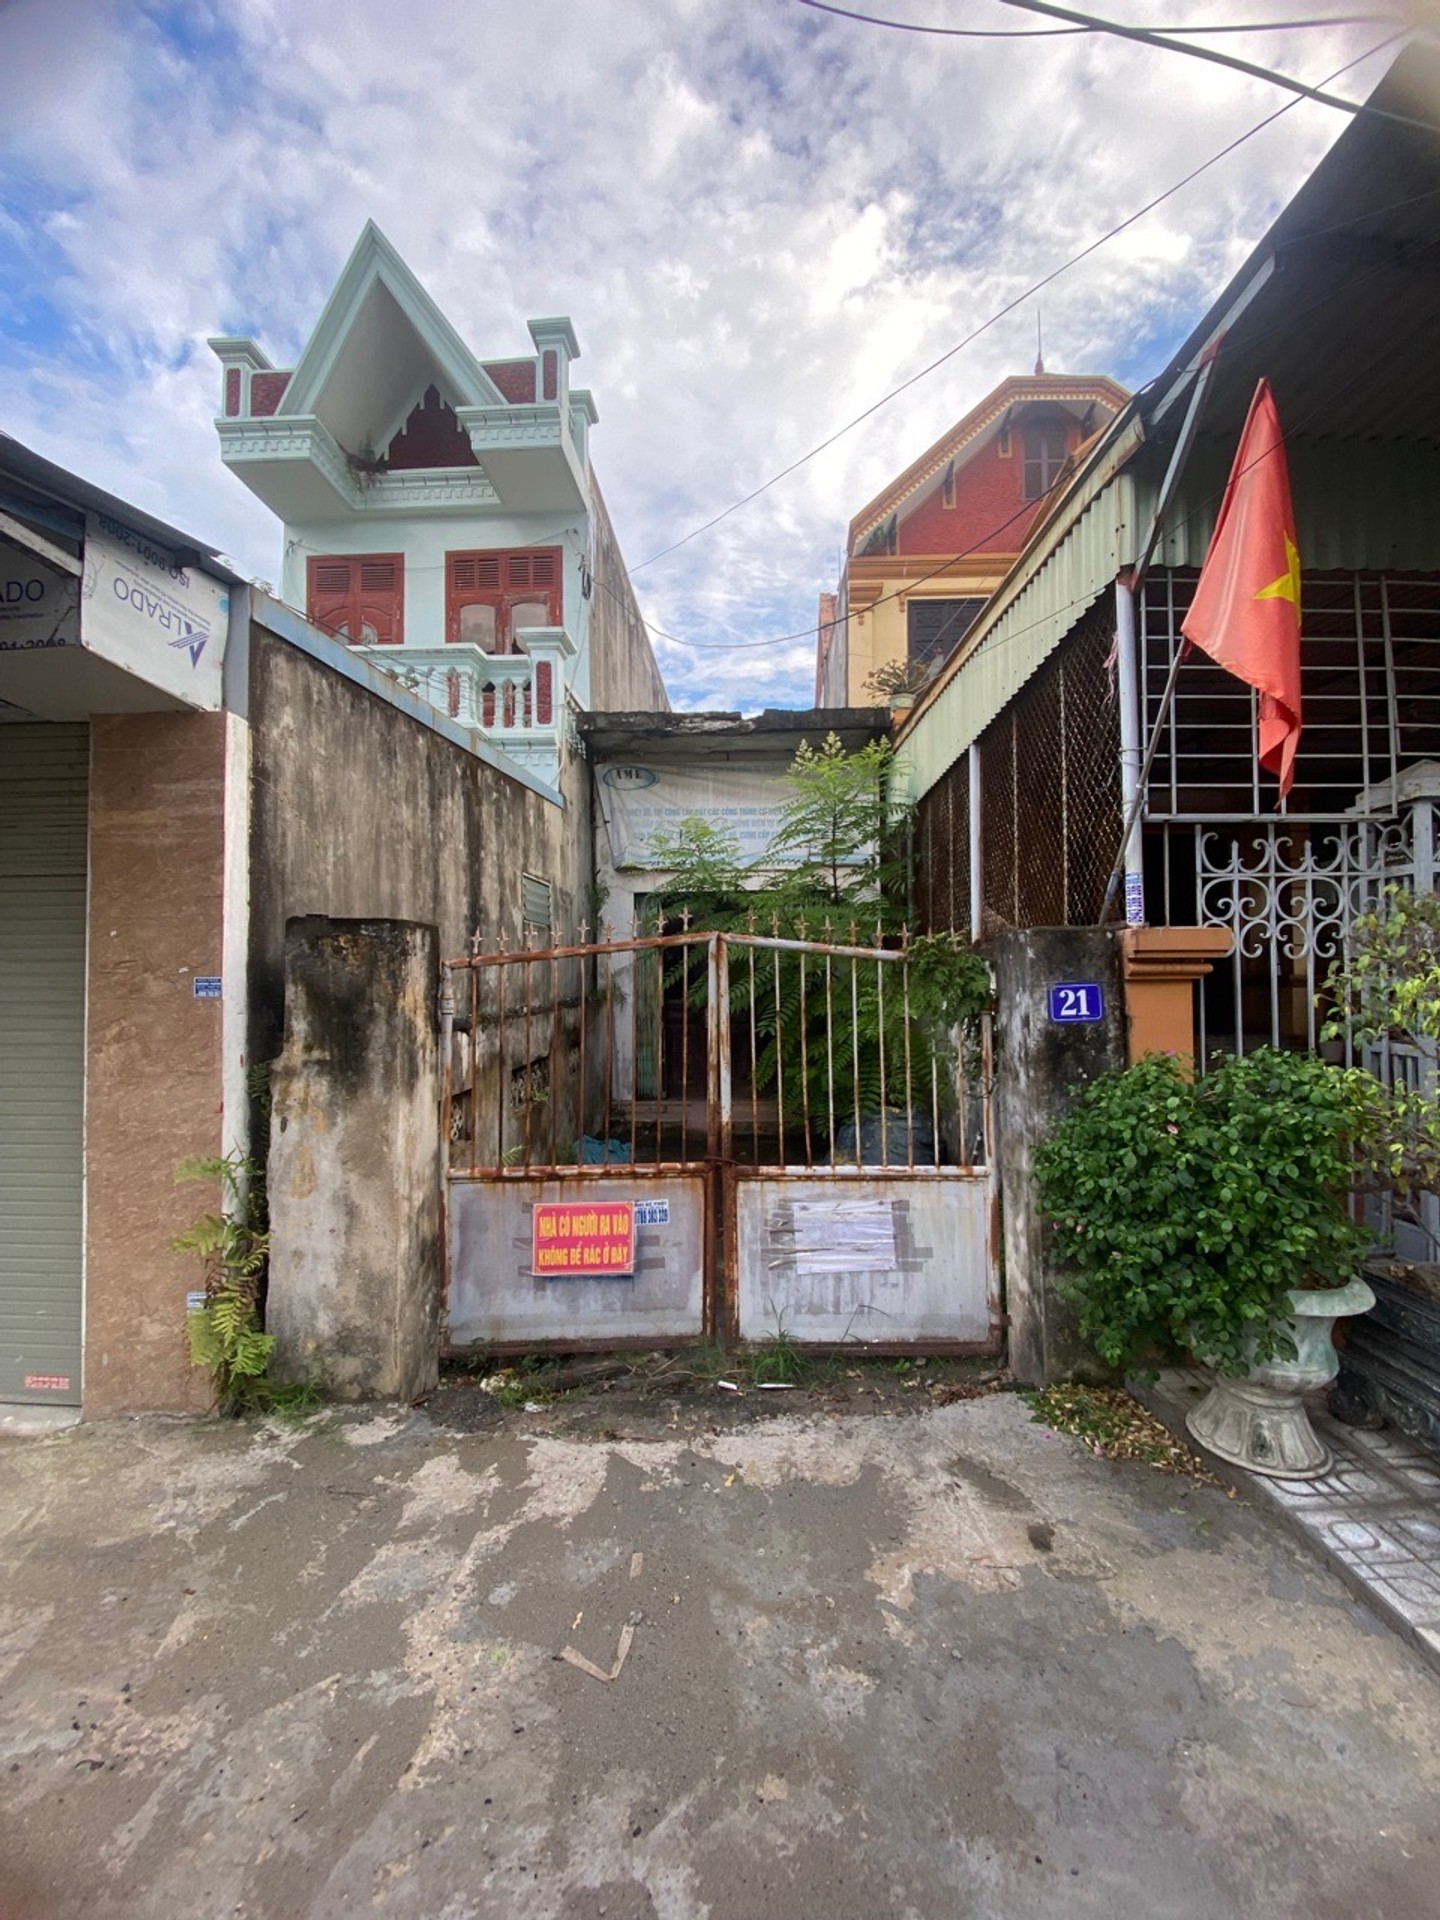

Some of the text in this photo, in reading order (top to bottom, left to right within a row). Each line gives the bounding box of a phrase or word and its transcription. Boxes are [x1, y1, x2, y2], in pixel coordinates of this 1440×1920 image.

[0, 578, 45, 603] DO
[113, 577, 209, 670] ALRADO
[1059, 988, 1090, 1016] 21
[539, 1209, 629, 1237] NHÀ CÓ NGƯỜI RA VÀO
[538, 1244, 568, 1265] KHÔNG
[583, 1244, 601, 1265] RÁC
[603, 1241, 610, 1264] Ở
[611, 1243, 629, 1264] ĐÂY
